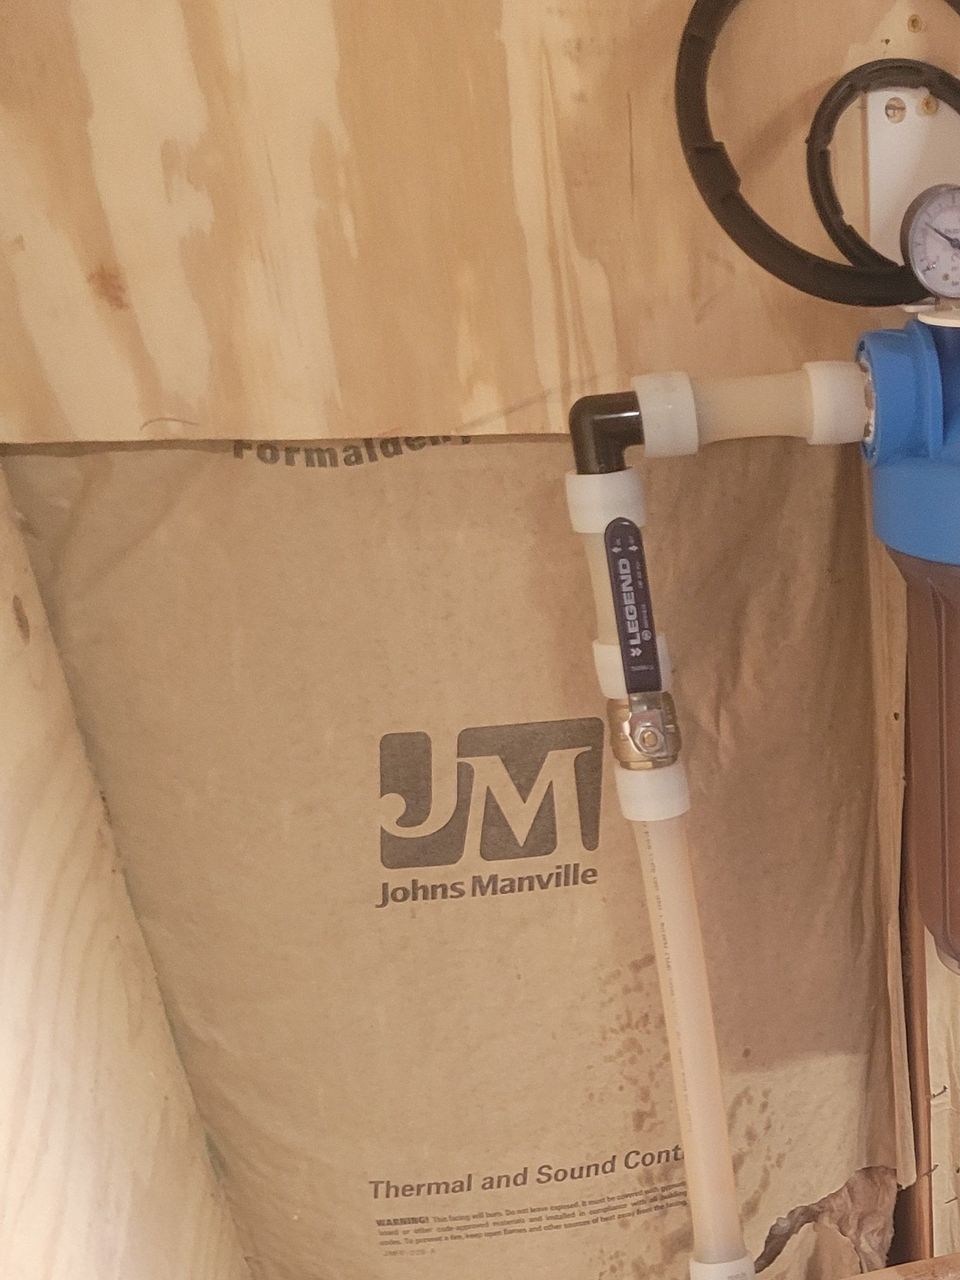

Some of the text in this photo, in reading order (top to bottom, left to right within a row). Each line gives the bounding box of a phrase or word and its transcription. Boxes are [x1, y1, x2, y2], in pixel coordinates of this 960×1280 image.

[233, 435, 473, 468] Formalde
[618, 558, 641, 645] LEGEND
[379, 716, 605, 870] JM
[375, 863, 598, 908] Johns Manville
[369, 1144, 685, 1200] Thermal and Sound Cont
